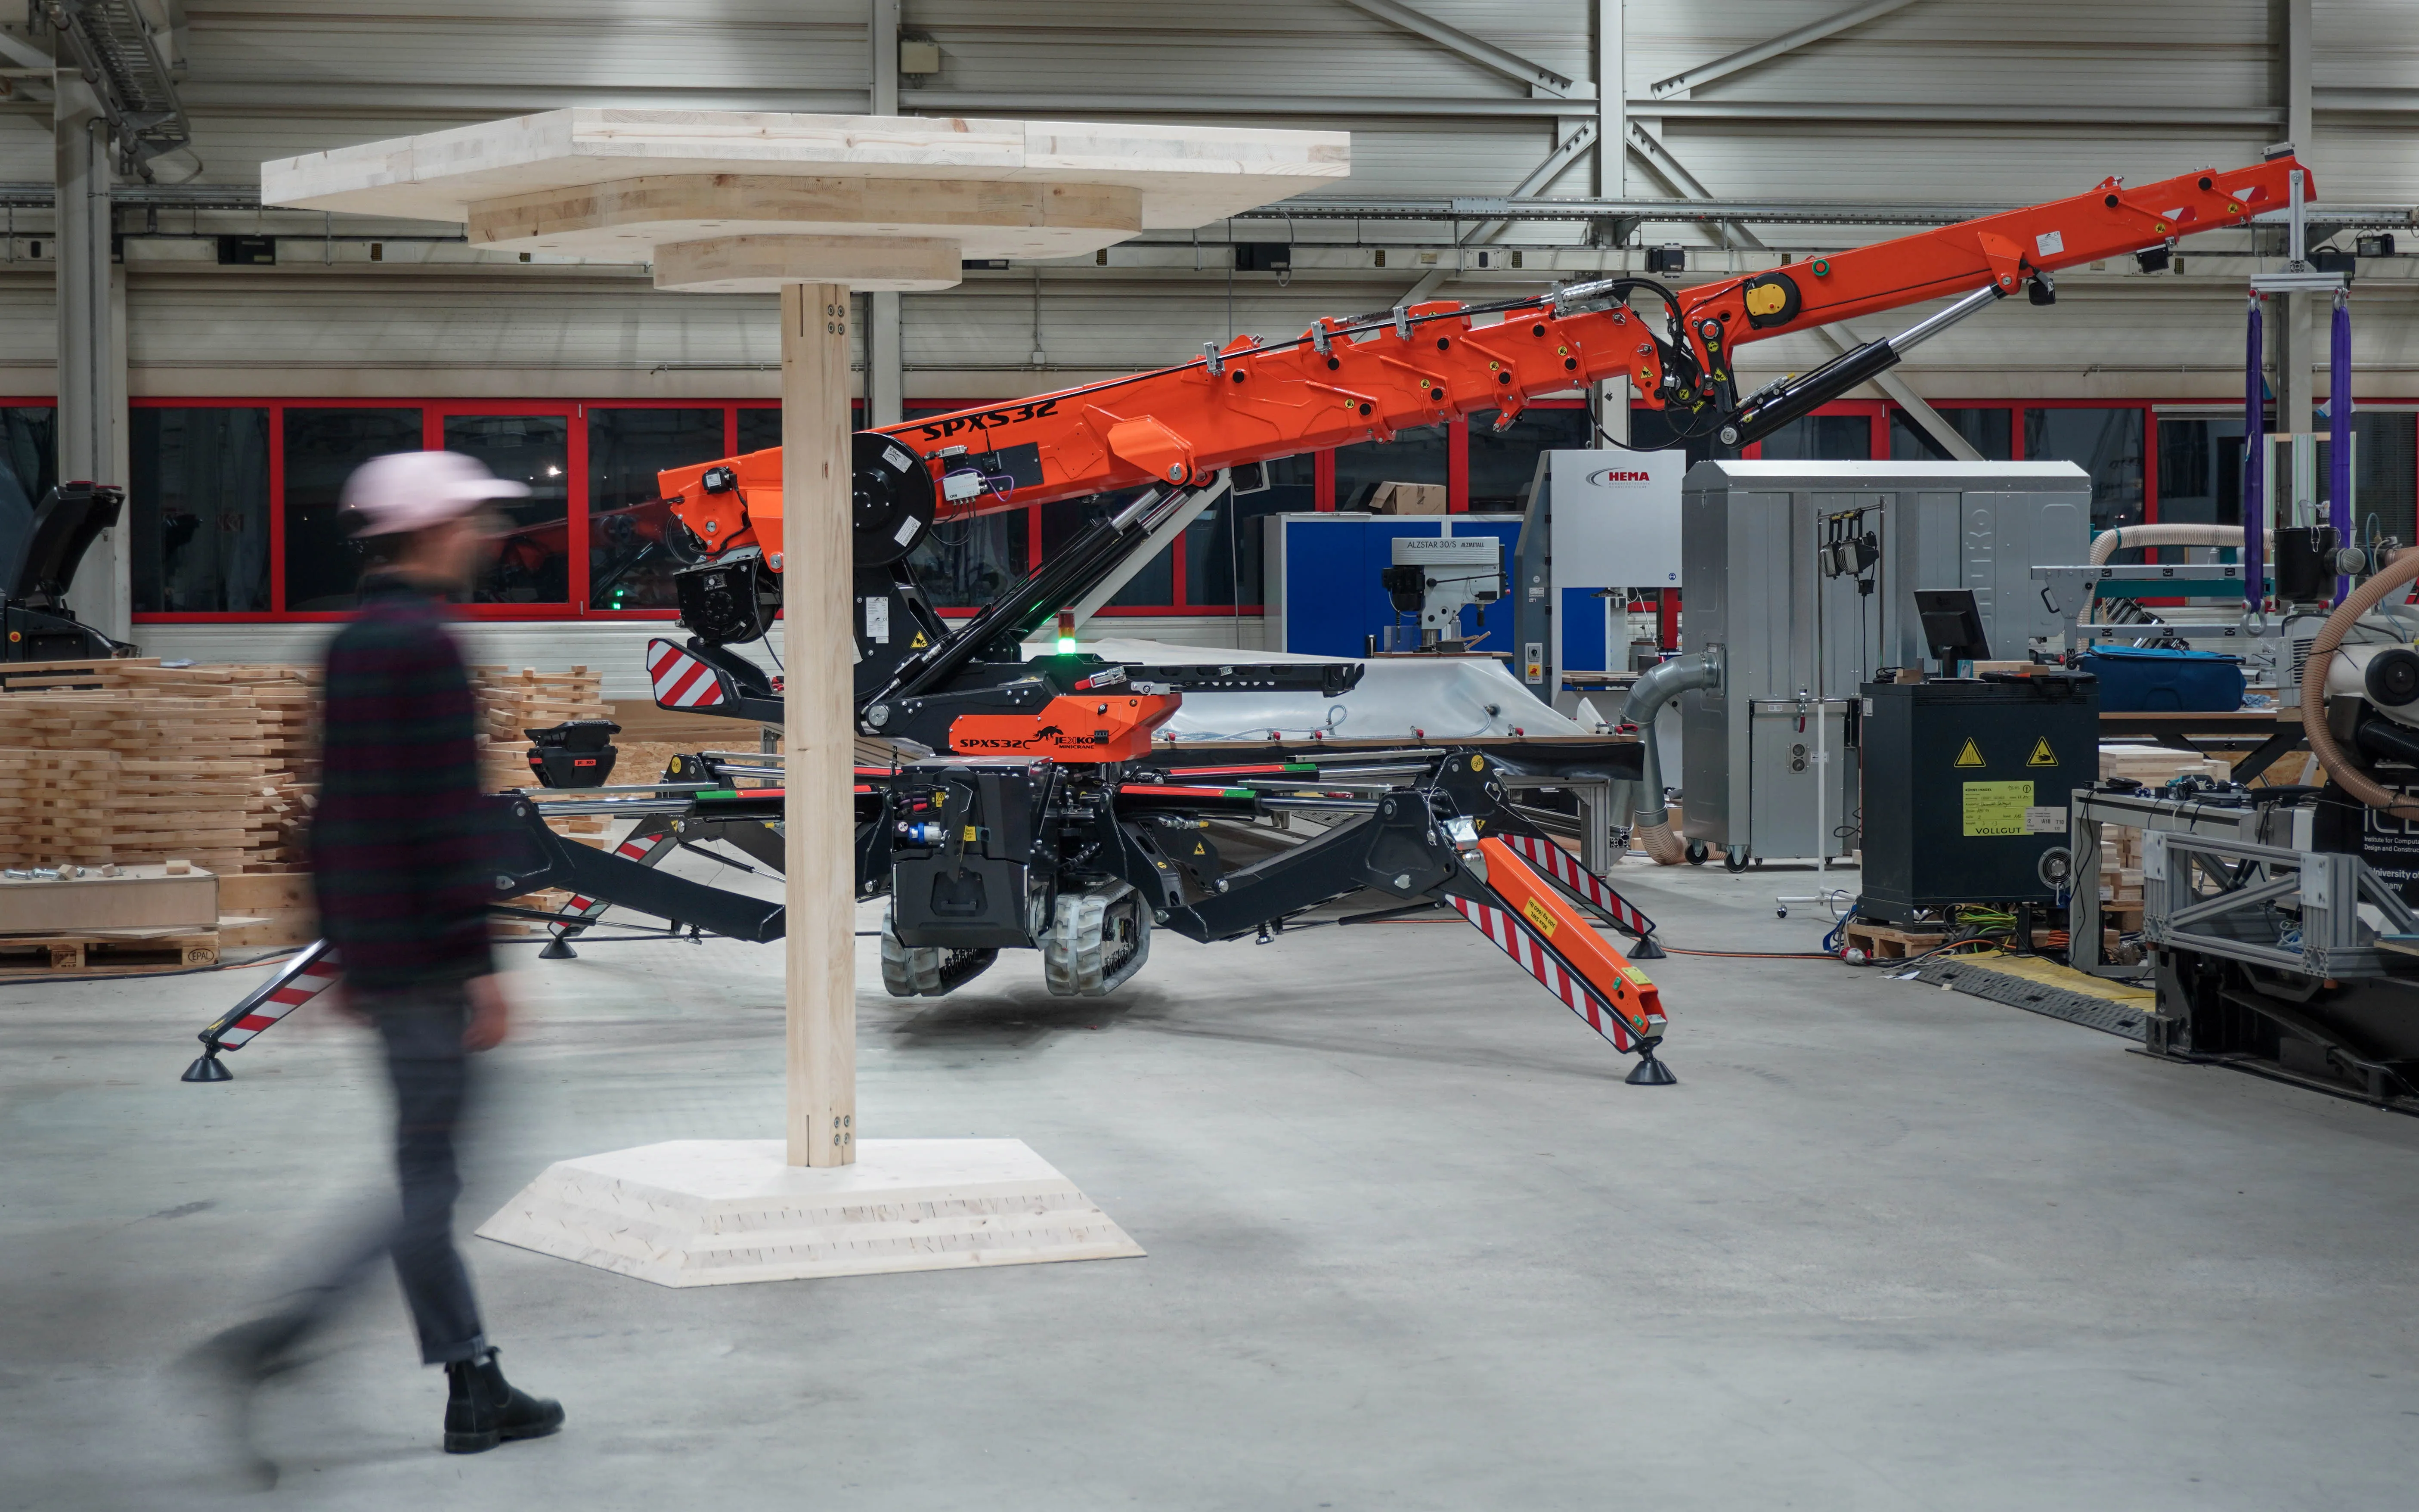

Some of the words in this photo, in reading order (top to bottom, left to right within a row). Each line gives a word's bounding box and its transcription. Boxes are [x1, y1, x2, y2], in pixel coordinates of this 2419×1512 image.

[1609, 472, 1650, 481] HEMA
[1054, 737, 1095, 745] JEKKO
[1533, 905, 1543, 916] (660
[1530, 911, 1539, 922] SWL
[1542, 913, 1548, 921] kg
[1539, 920, 1548, 930] Max
[1548, 919, 1556, 929] 300
[192, 952, 210, 960] EPAL
